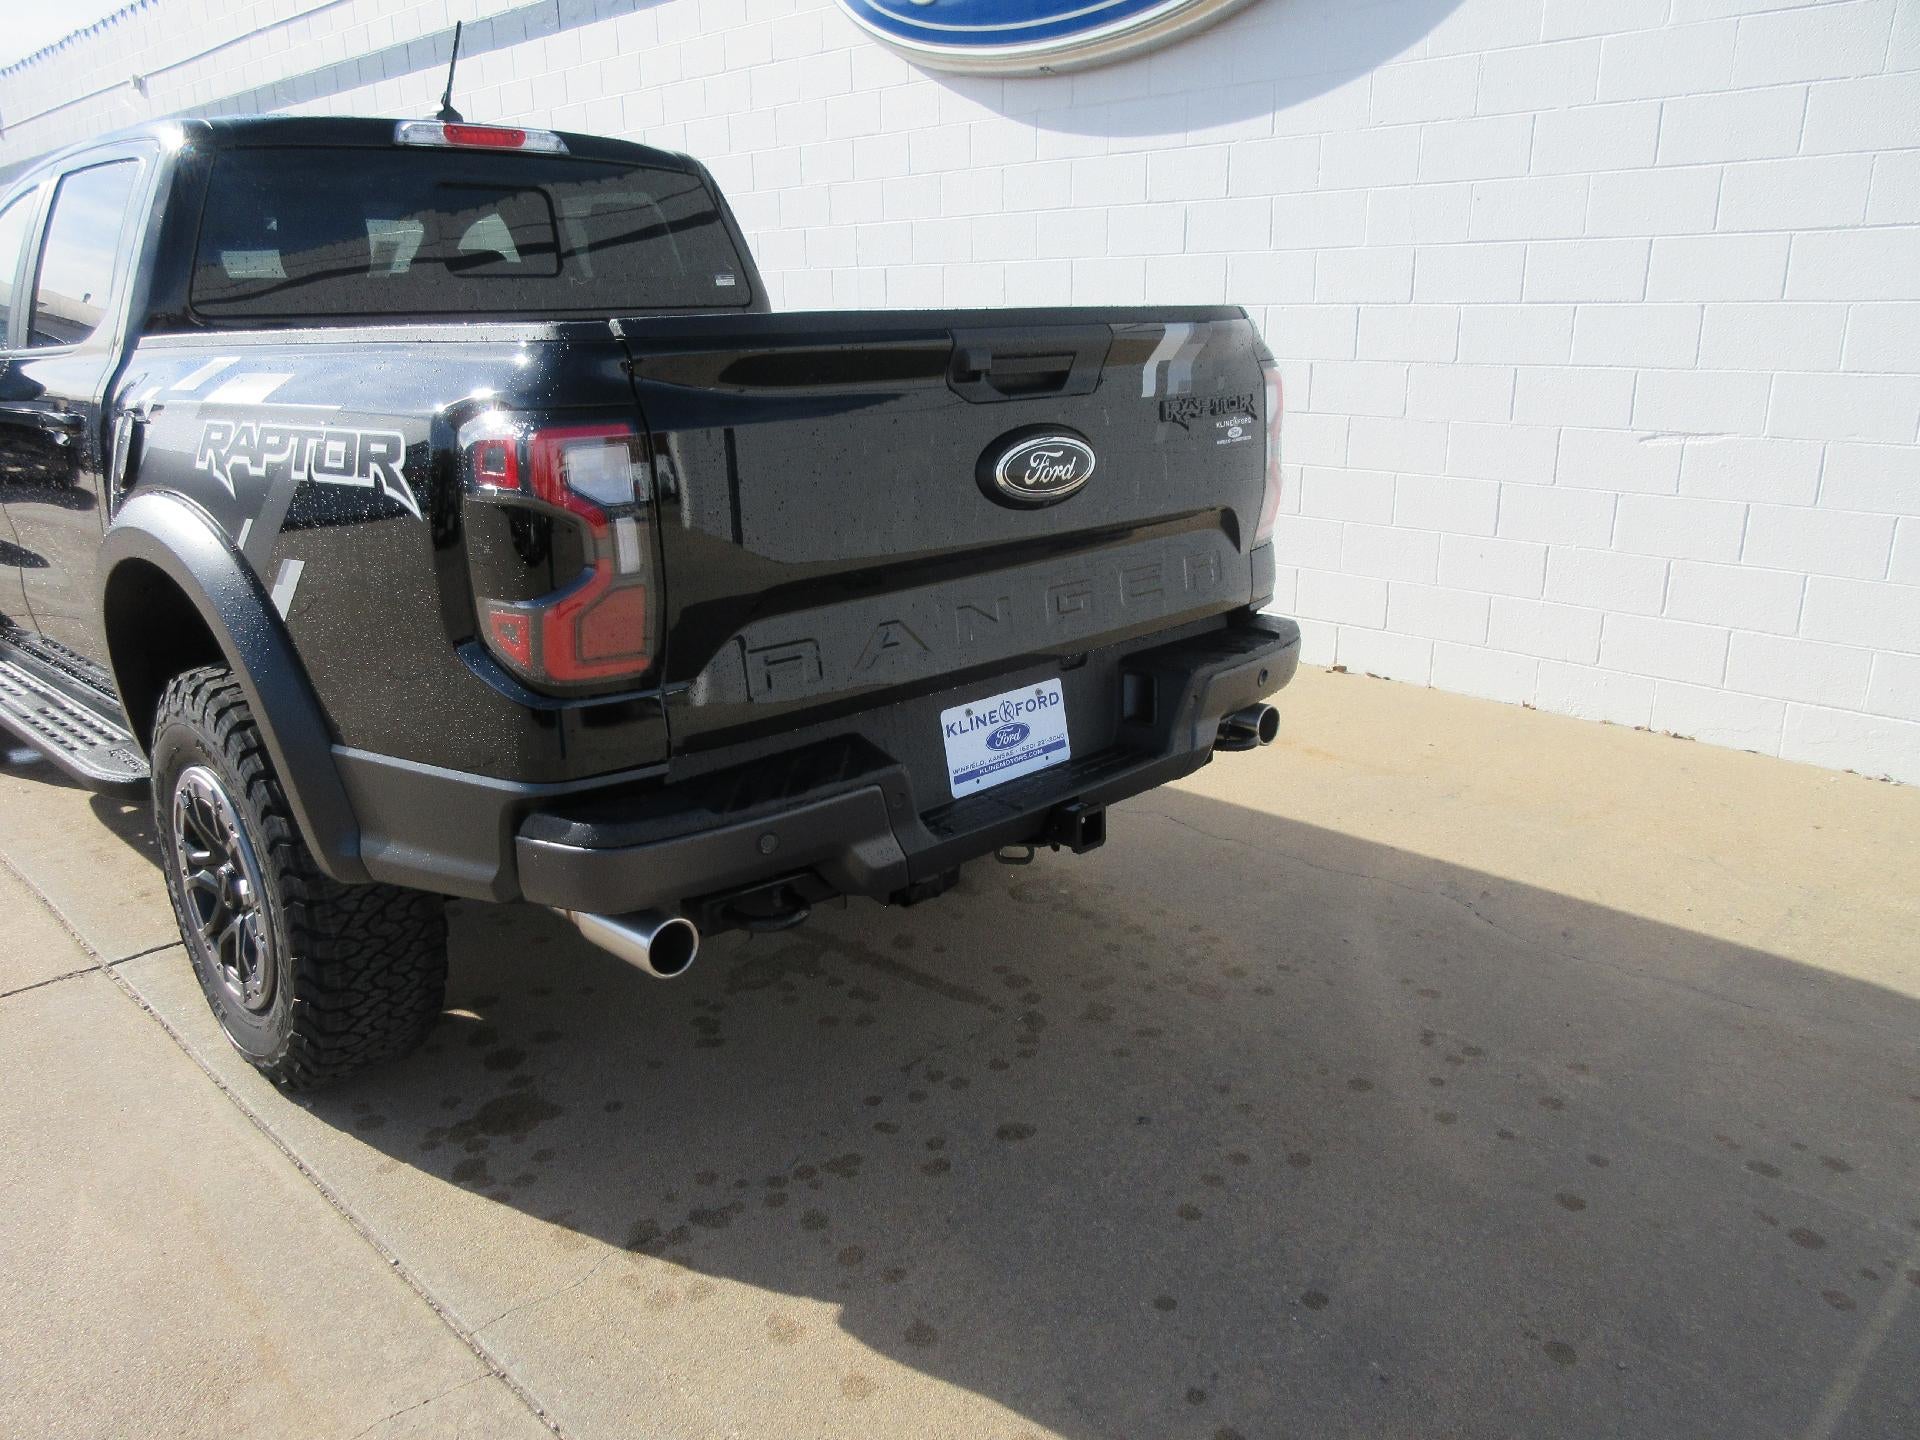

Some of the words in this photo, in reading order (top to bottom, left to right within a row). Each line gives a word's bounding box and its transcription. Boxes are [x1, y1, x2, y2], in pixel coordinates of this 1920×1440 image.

[1159, 394, 1257, 431] RAPTOR
[195, 420, 423, 521] RAPTOR
[1024, 450, 1077, 485] Ford
[747, 551, 1222, 694] RANGER
[945, 710, 999, 738] KLINE
[1015, 691, 1060, 717] FORD
[995, 727, 1021, 747] Ford
